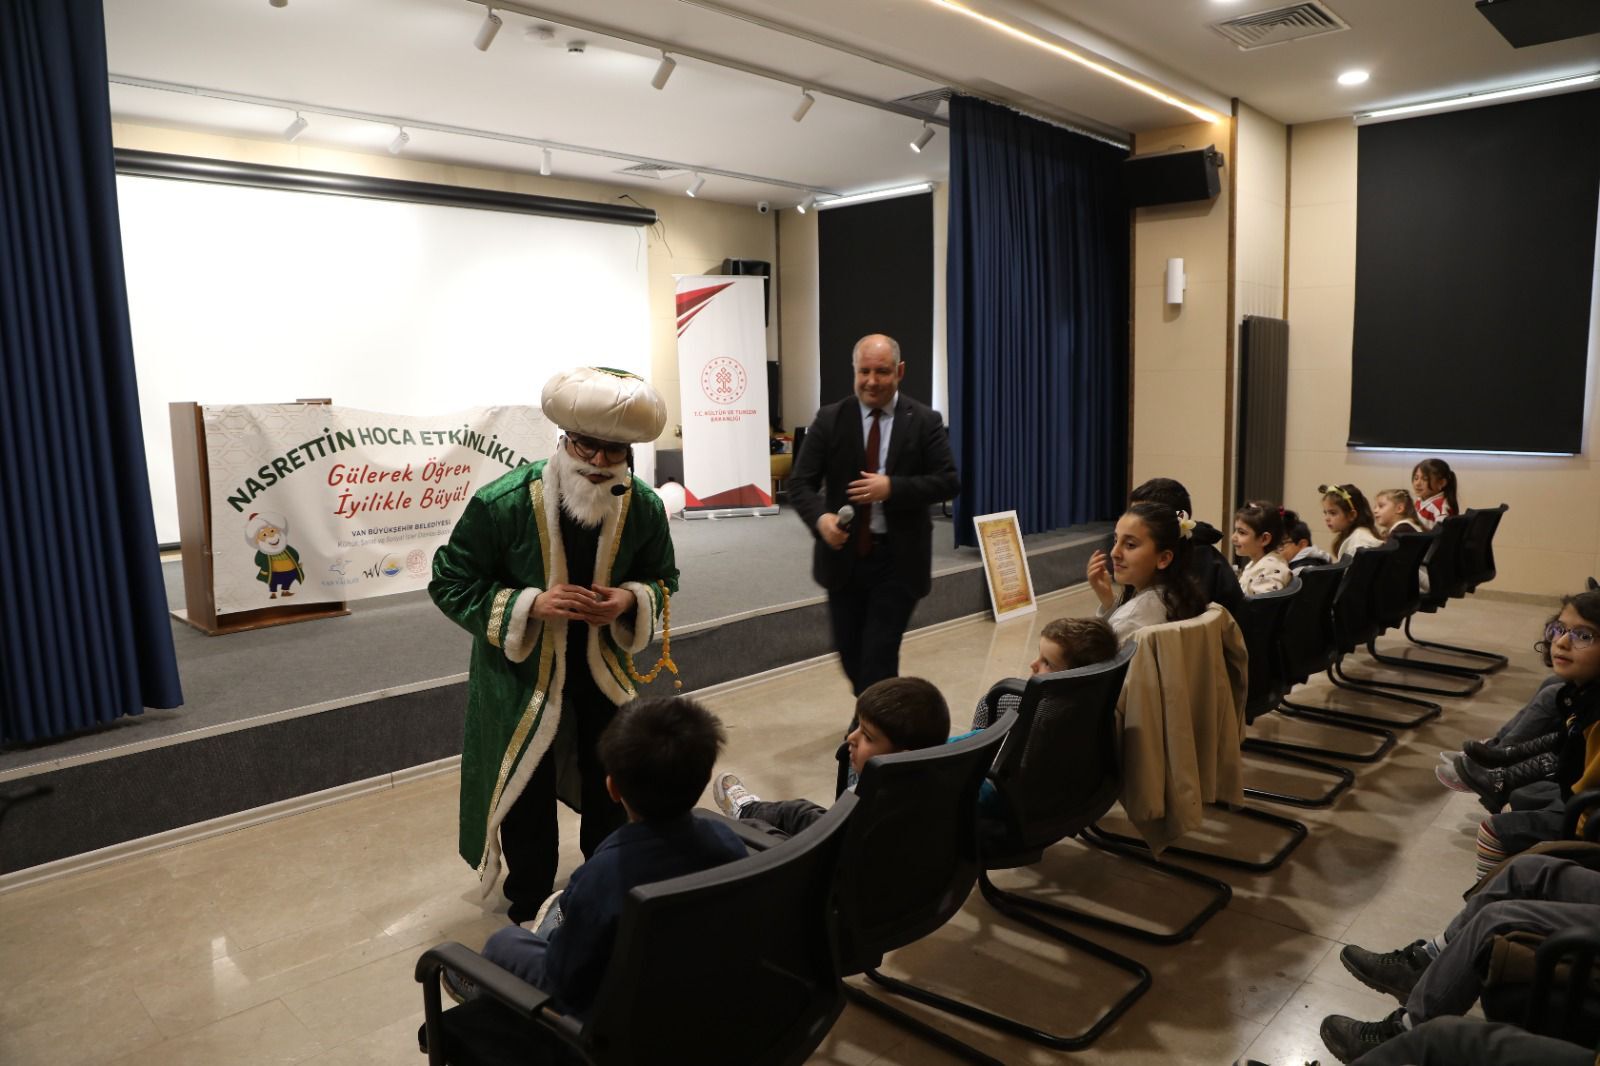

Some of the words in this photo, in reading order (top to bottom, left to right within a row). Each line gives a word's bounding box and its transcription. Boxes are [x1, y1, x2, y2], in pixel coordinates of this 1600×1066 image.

[227, 427, 357, 513] NASRETTİN
[357, 427, 416, 445] HOCA
[328, 463, 413, 486] Gülerek
[421, 457, 471, 484] Öğren
[334, 488, 412, 519] İyilikle
[420, 481, 470, 509] Büyü!
[352, 529, 367, 537] VAN
